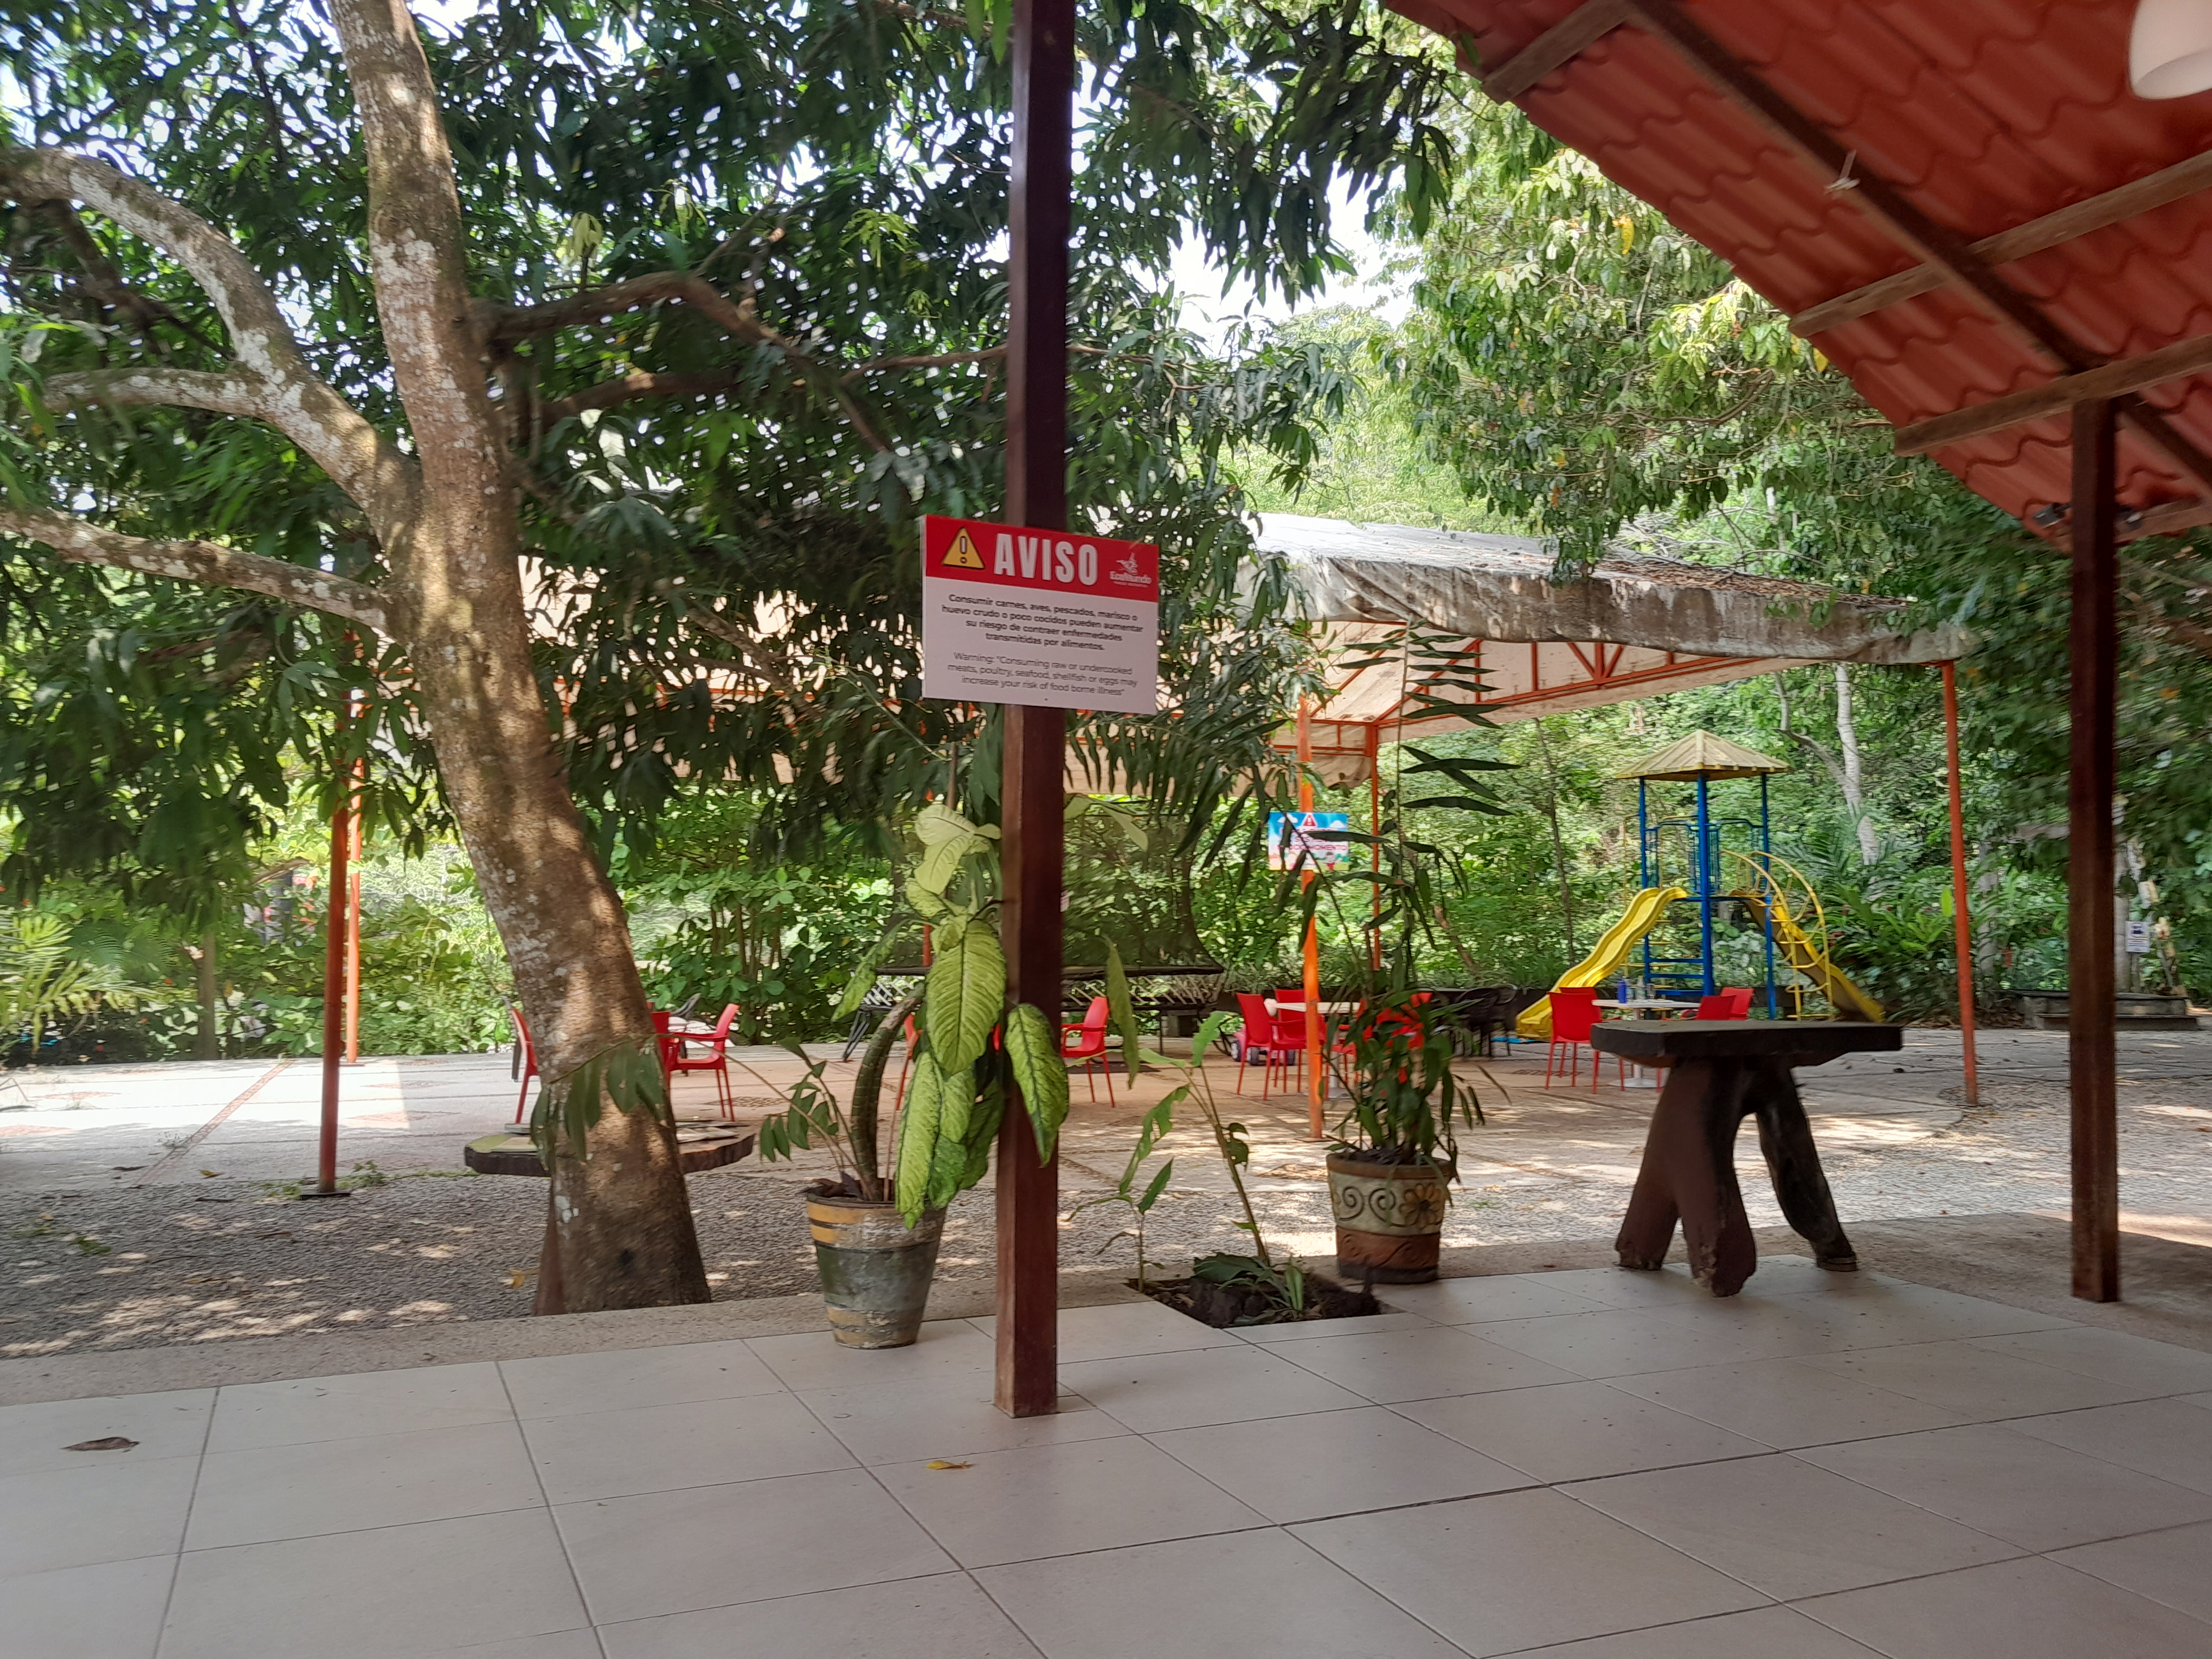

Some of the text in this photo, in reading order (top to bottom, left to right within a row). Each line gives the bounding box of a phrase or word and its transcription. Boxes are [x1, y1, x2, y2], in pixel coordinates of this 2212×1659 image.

[993, 533, 1098, 586] AVISO
[942, 604, 971, 615] huevo
[973, 609, 1000, 618] crudo
[1034, 615, 1068, 625] cocidos
[1069, 619, 1102, 628] pueden
[1103, 623, 1143, 633] aumentar
[948, 594, 994, 606] Consumir
[995, 600, 1028, 610] carnes,
[1030, 604, 1052, 612] aves,
[1053, 607, 1096, 617] pescados,
[1097, 611, 1130, 620] marisco
[979, 620, 1007, 631] riesgo
[1023, 626, 1060, 635] contraer
[1062, 629, 1123, 641] enfermedades
[986, 633, 1042, 645] transmitidas
[1060, 639, 1105, 651] alimentos.
[953, 652, 995, 665] Warning:
[1079, 665, 1133, 675] undercooked
[948, 665, 978, 673] meats,
[1052, 672, 1086, 681] shellfish
[1098, 678, 1119, 686] eggs
[1120, 679, 1138, 688] may
[961, 675, 1000, 686] increase
[1023, 681, 1039, 689] risk
[1050, 683, 1070, 691] food
[1071, 685, 1095, 693] borne
